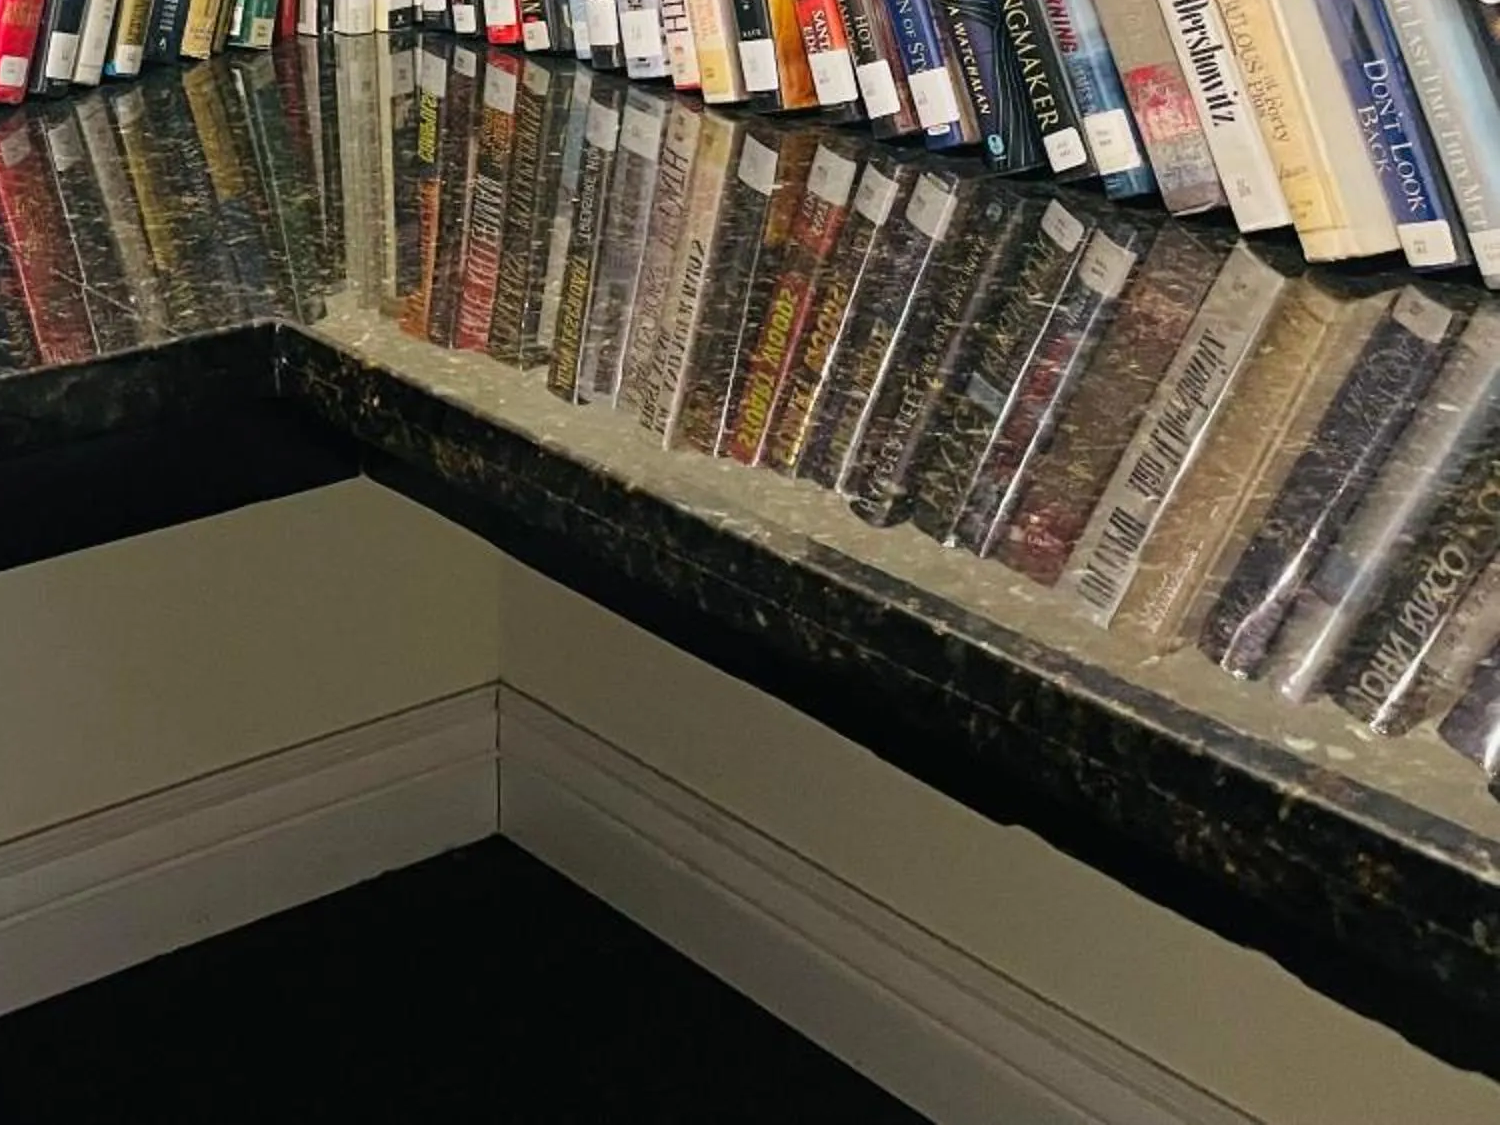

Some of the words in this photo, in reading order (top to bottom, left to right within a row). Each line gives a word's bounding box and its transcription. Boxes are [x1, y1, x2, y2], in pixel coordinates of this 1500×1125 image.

[853, 15, 873, 51] HOT
[901, 18, 917, 39] OF
[951, 21, 991, 116] WATCHMAN
[1399, 16, 1434, 67] LAST
[1418, 72, 1452, 124] TIME
[1355, 104, 1394, 175] BACK
[1361, 57, 1406, 135] DON'T
[1388, 140, 1429, 213] LOOK
